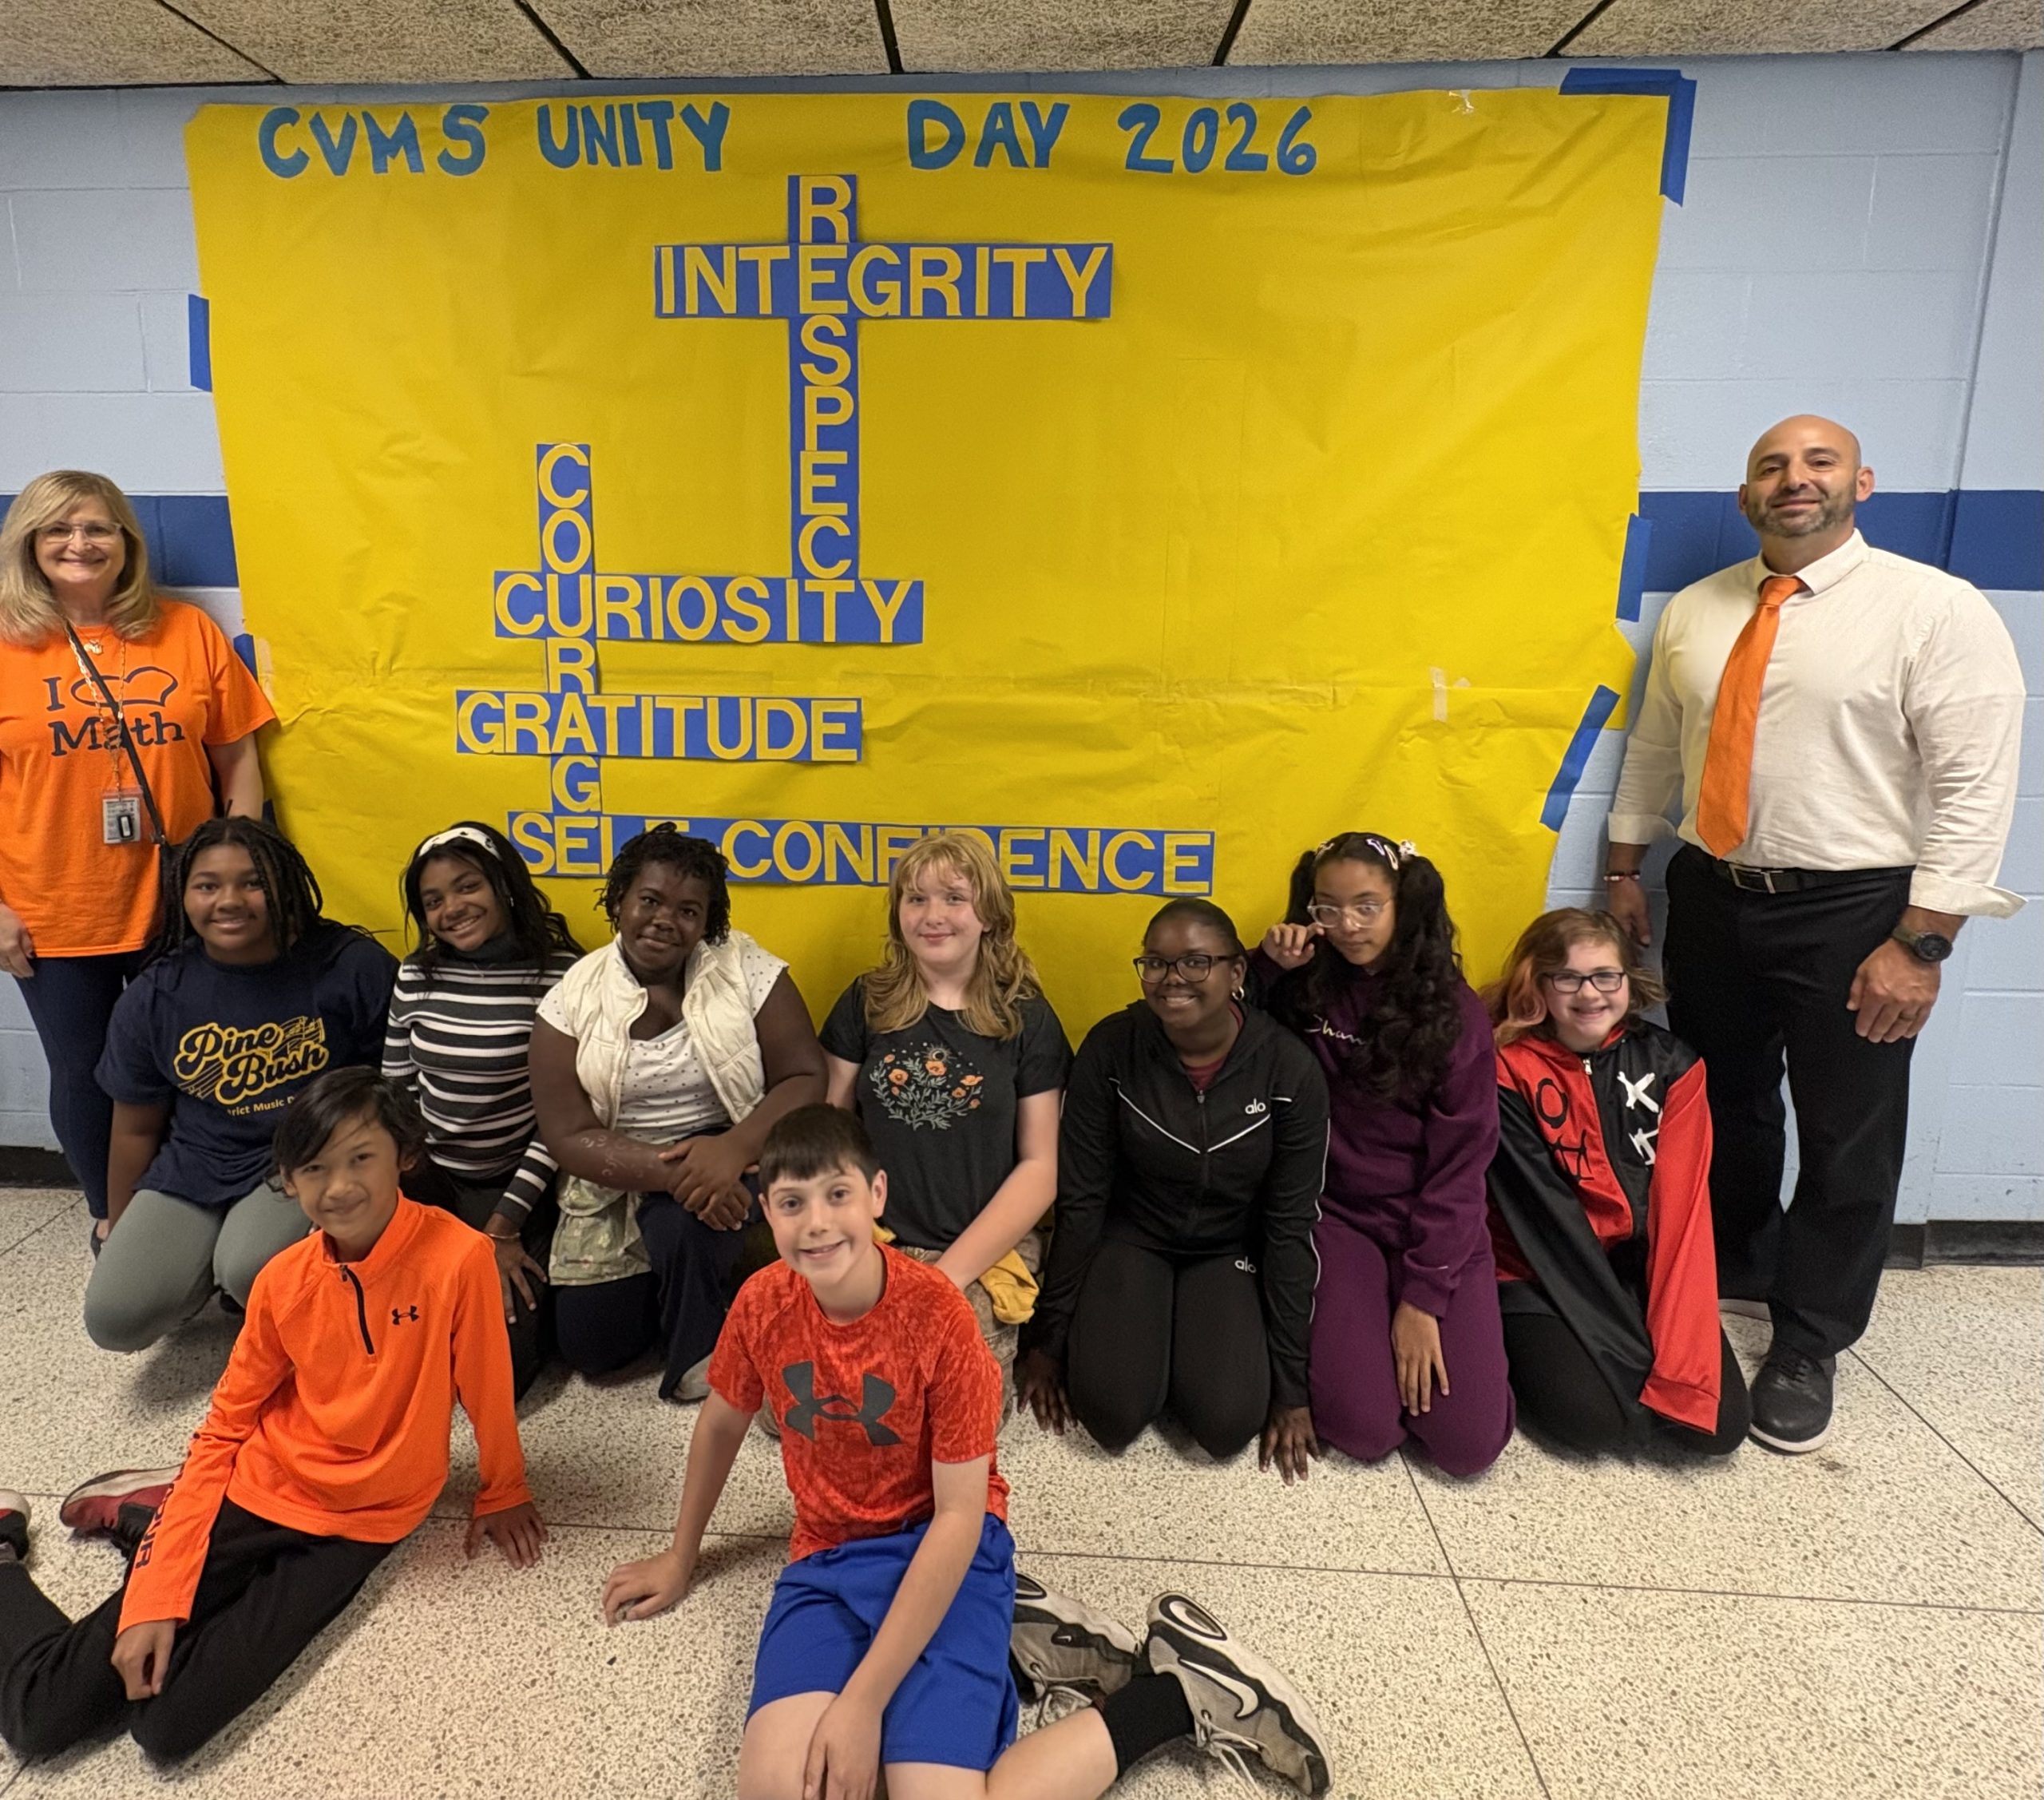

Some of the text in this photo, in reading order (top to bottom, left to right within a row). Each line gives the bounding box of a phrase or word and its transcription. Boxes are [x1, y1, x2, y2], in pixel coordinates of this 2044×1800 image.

[258, 100, 1317, 178] CVMS UNITY DAY 2026
[660, 244, 1108, 318] INTEGRITY
[798, 175, 855, 642] RESPECT
[495, 573, 913, 643] CURIOSITY
[538, 444, 600, 874] COURAGE
[43, 677, 65, 711] I
[48, 712, 184, 756] Math
[458, 692, 858, 761] GRATITUDE
[173, 1022, 284, 1080] Pine
[215, 1041, 330, 1104] Bush
[253, 1099, 285, 1112] Music
[1245, 1099, 1266, 1115] alo
[1234, 1256, 1256, 1274] alo
